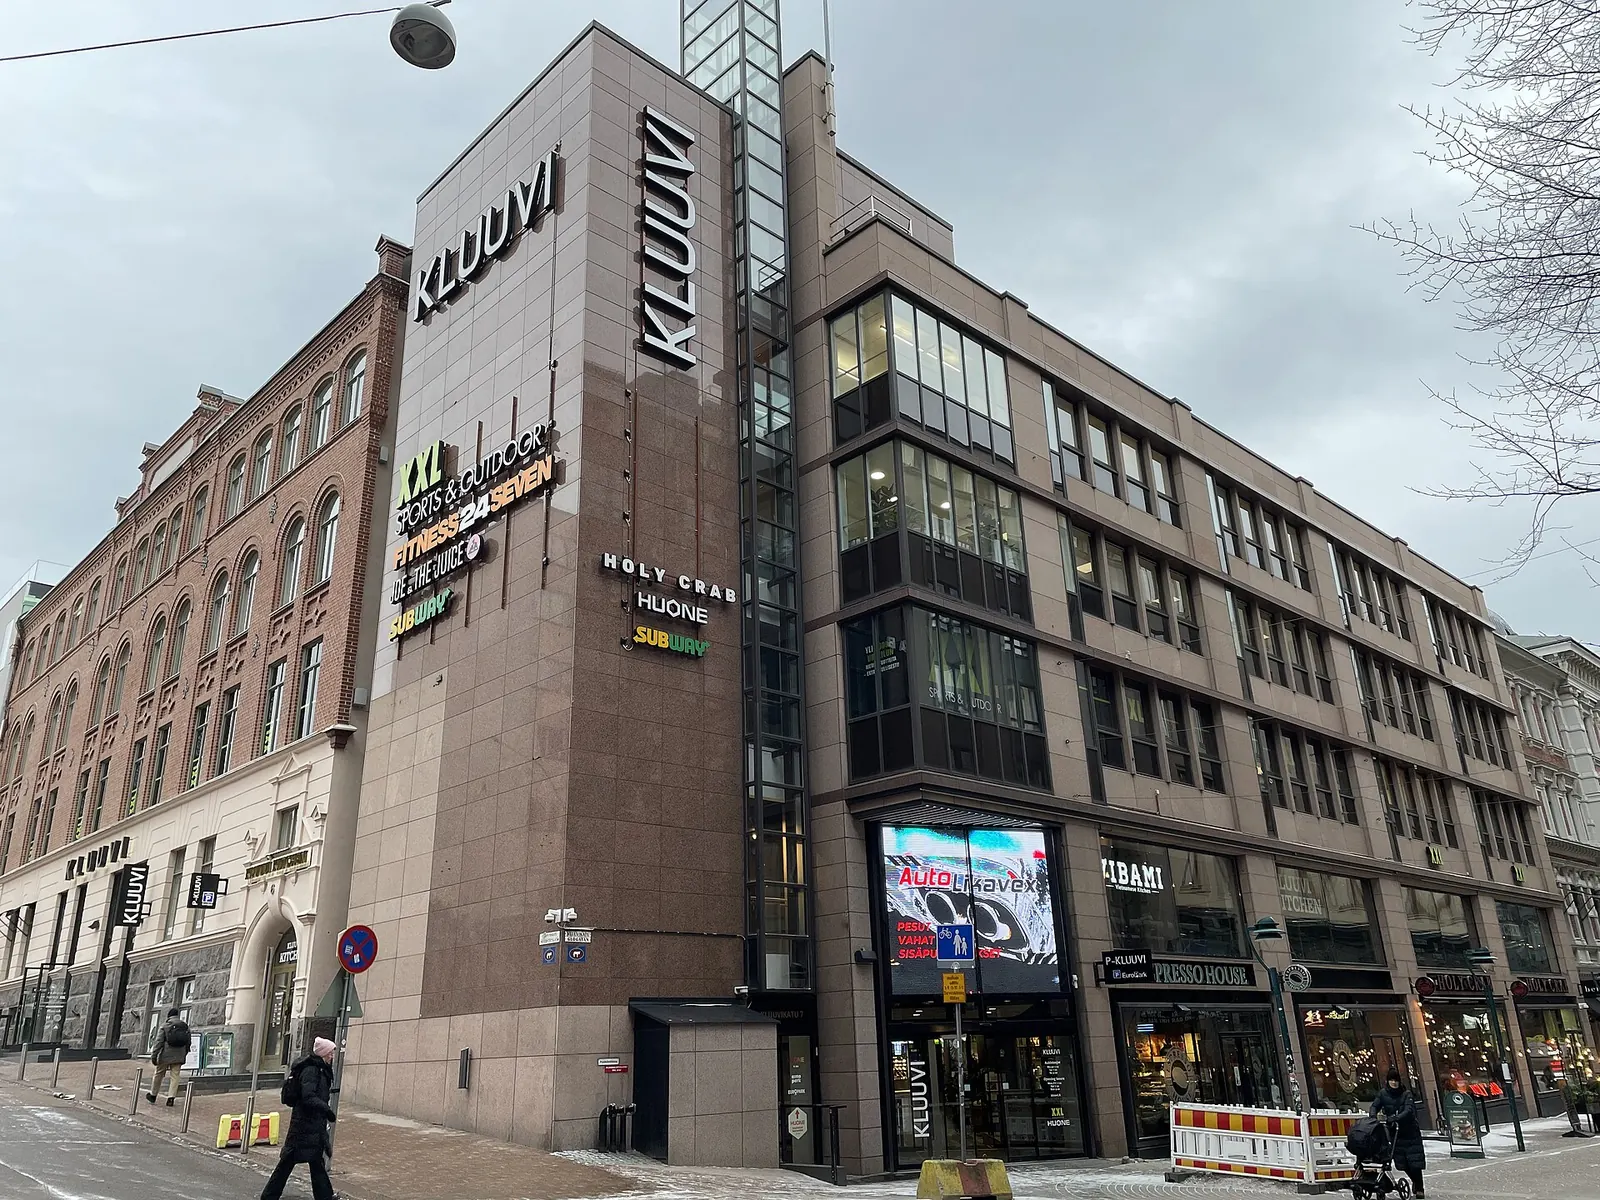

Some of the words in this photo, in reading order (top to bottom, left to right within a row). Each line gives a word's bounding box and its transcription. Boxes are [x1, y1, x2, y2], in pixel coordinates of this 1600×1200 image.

[413, 150, 556, 322] KLUUVI
[642, 105, 697, 371] KLUUVI
[395, 487, 442, 534] SPORTS
[445, 479, 457, 503] &
[460, 424, 542, 493] OUTDOOR
[396, 440, 442, 508] XXL
[389, 575, 408, 604] JOE
[414, 560, 433, 590] THE
[433, 540, 465, 579] JUICE
[604, 552, 665, 582] HOLY
[678, 575, 736, 602] CRAB
[388, 588, 453, 639] SUBWAY
[638, 592, 708, 624] HUONE
[633, 626, 711, 656] SUBWAY
[123, 867, 147, 923] KLUUVI
[192, 875, 202, 906] P-KLUUVI
[270, 884, 276, 895] 6
[897, 921, 932, 932] PESUT
[897, 935, 935, 945] VAHAT
[1105, 954, 1147, 966] P-KLUUVI
[1153, 963, 1202, 985] PRESSO
[1204, 966, 1248, 985] HOUSE
[910, 1061, 930, 1138] KLUUVI
[1051, 1107, 1065, 1117] XXL
